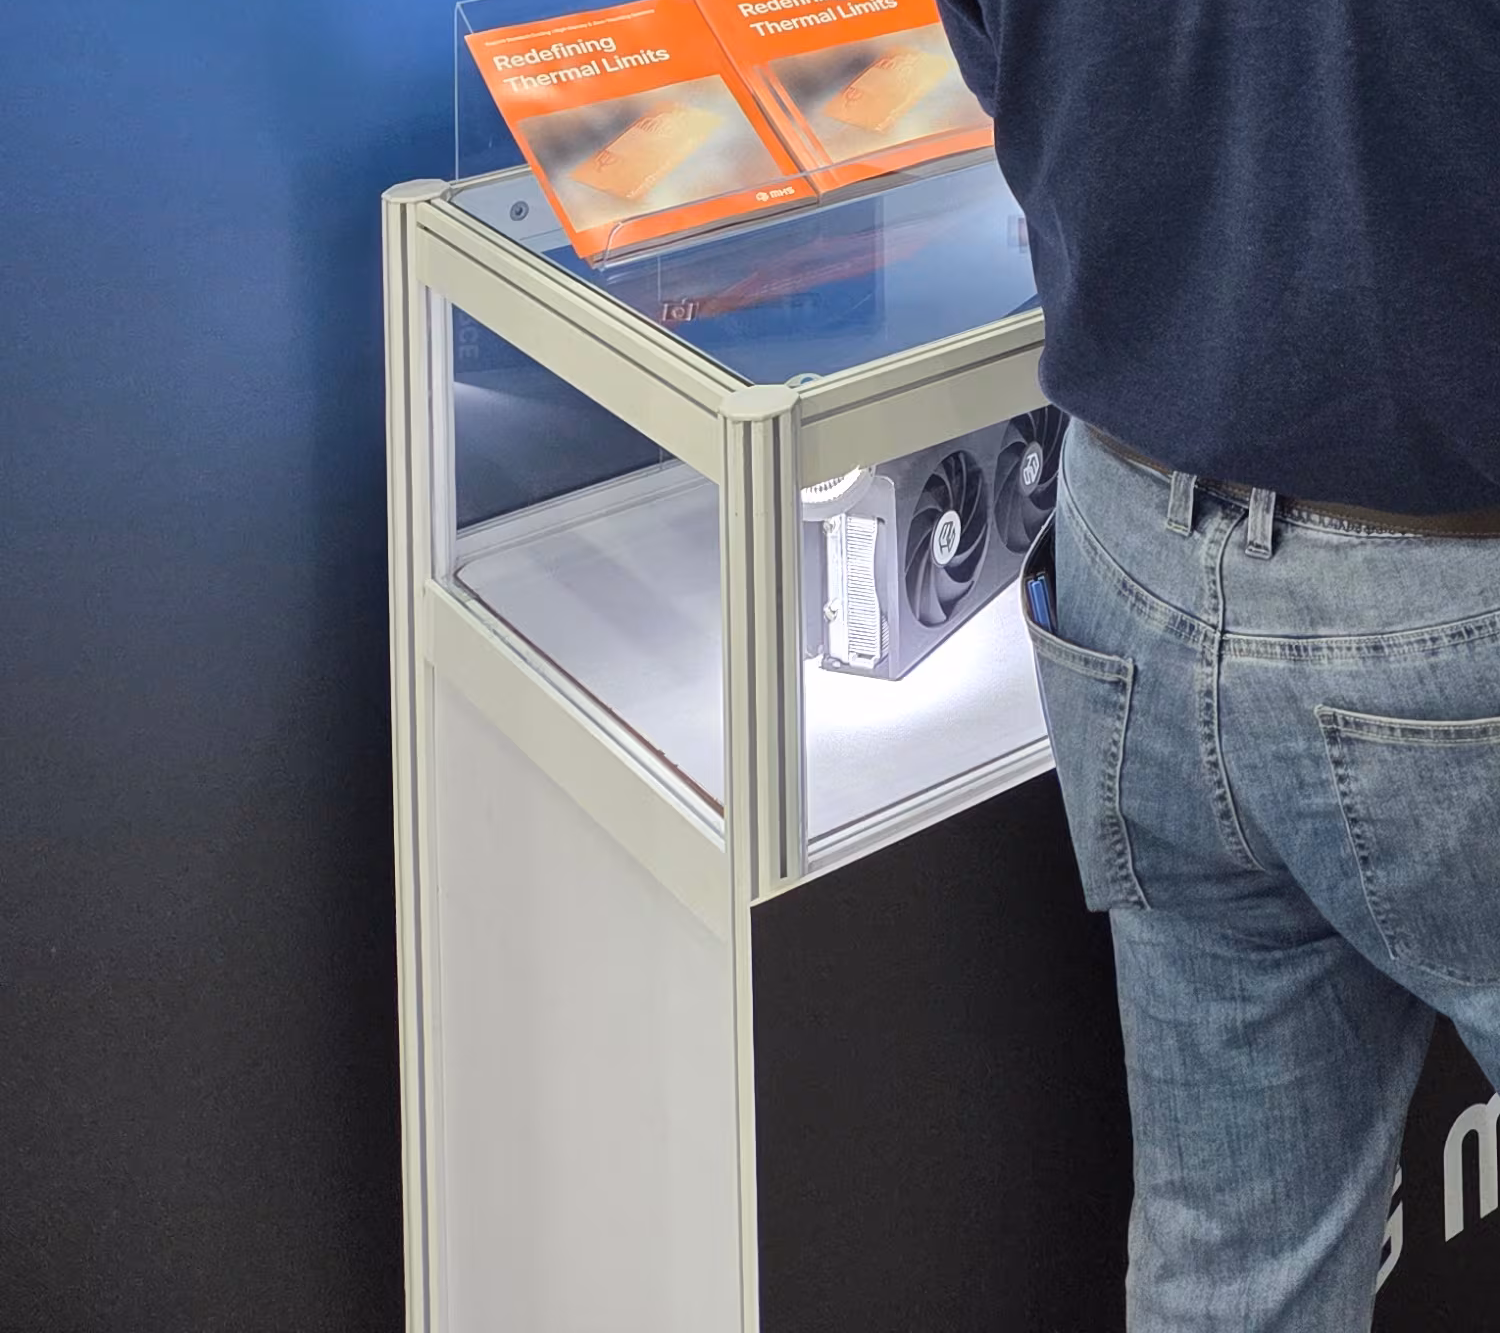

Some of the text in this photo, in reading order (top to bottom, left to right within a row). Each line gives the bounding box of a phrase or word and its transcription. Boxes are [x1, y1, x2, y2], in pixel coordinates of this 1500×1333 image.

[750, 7, 838, 37] Thermal
[492, 36, 617, 72] Redefining
[503, 48, 671, 93] Thermal Limits
